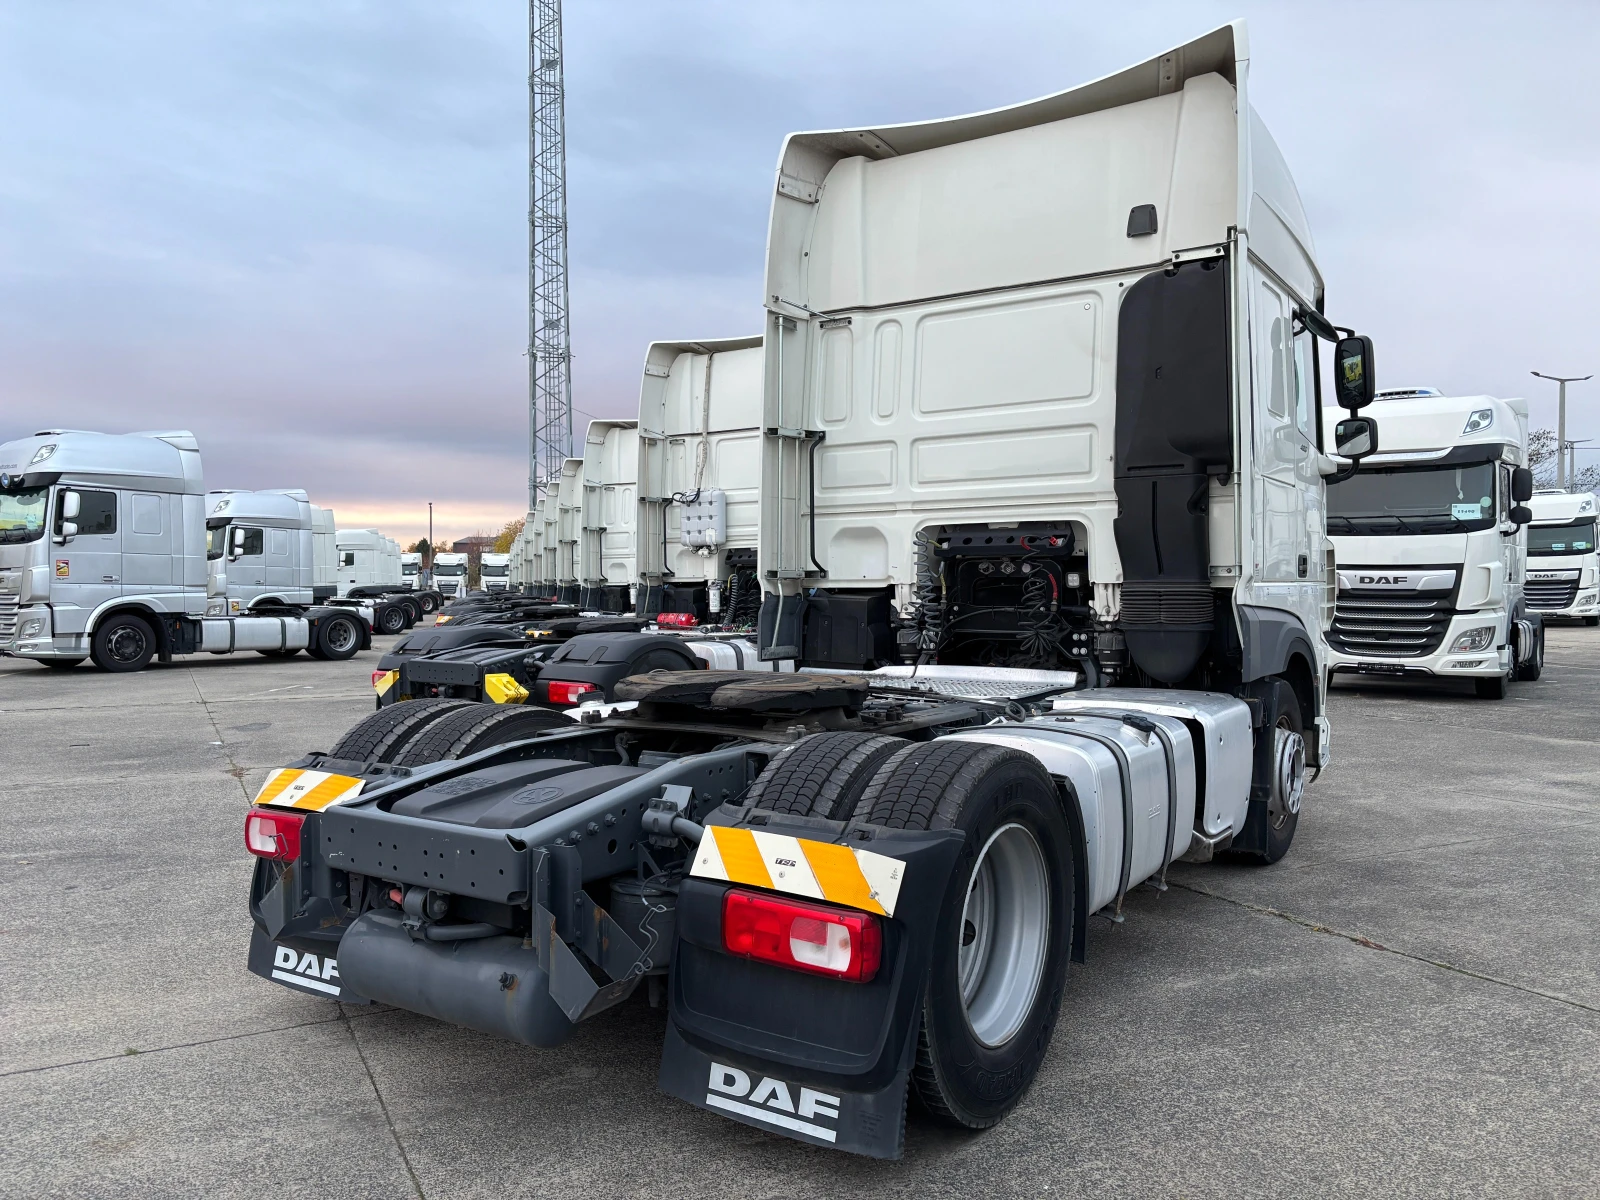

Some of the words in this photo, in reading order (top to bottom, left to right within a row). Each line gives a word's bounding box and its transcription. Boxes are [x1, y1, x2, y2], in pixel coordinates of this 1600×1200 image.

[1359, 576, 1408, 585] DAF
[273, 945, 340, 981] DAF
[708, 1061, 841, 1119] DAF
